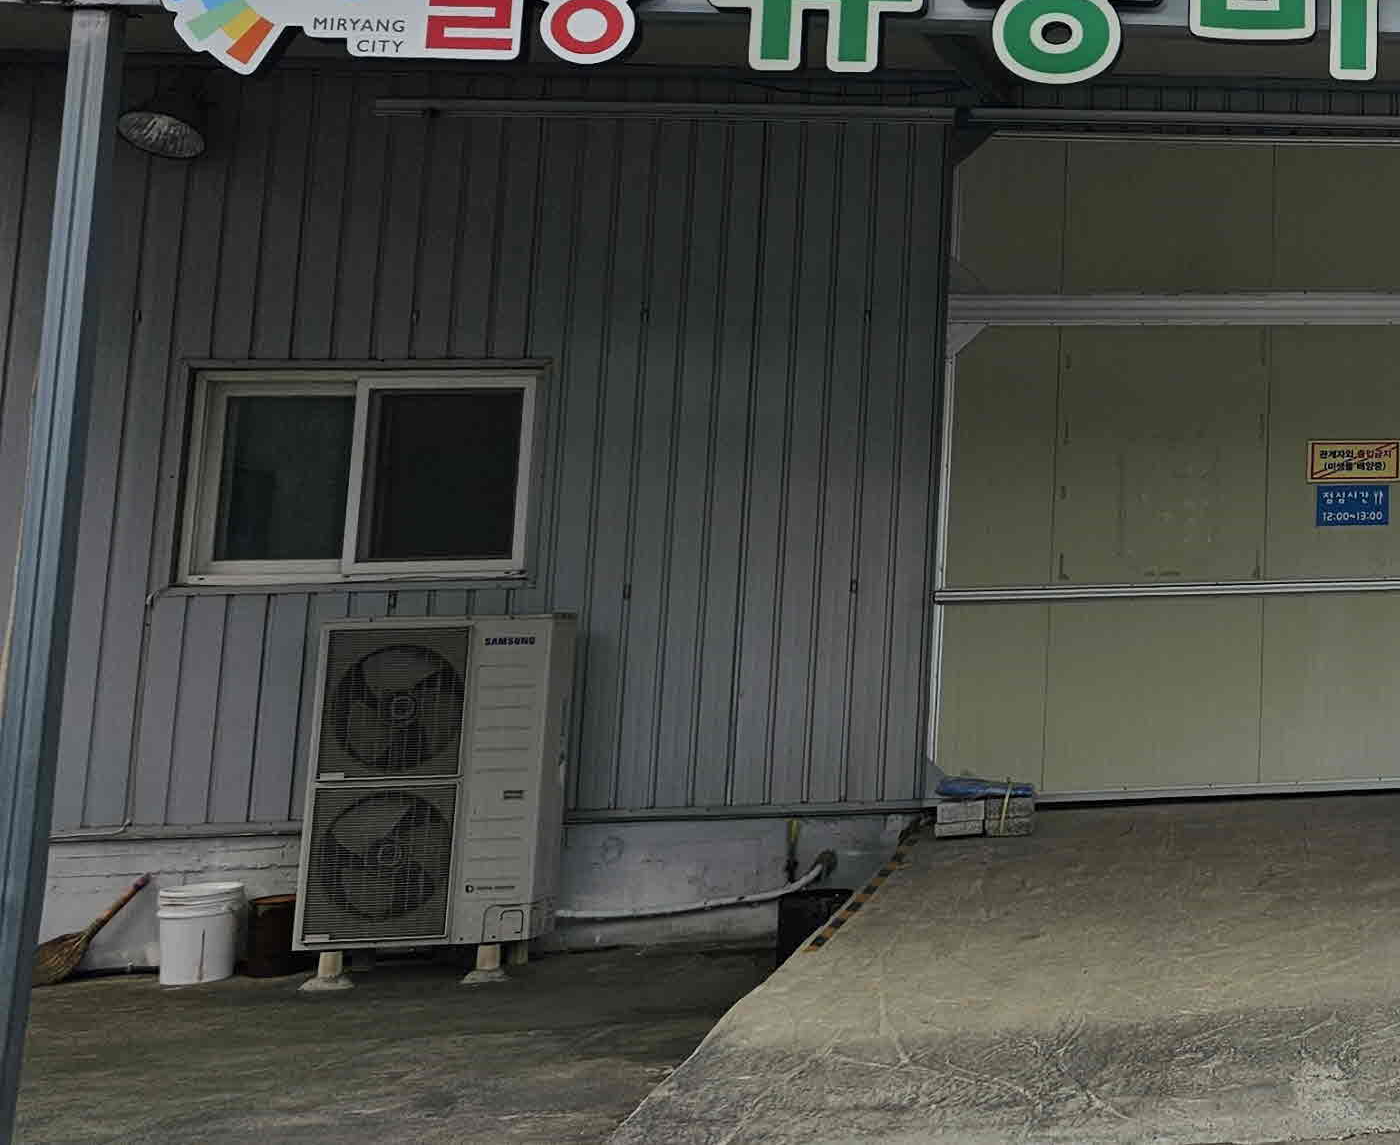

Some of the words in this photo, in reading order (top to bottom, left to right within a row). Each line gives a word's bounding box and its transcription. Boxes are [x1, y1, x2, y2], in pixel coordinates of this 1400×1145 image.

[313, 15, 406, 34] MIRYANG
[356, 38, 405, 54] CITY
[1322, 491, 1369, 504] 점심시간
[485, 636, 536, 646] SAMSUNG
